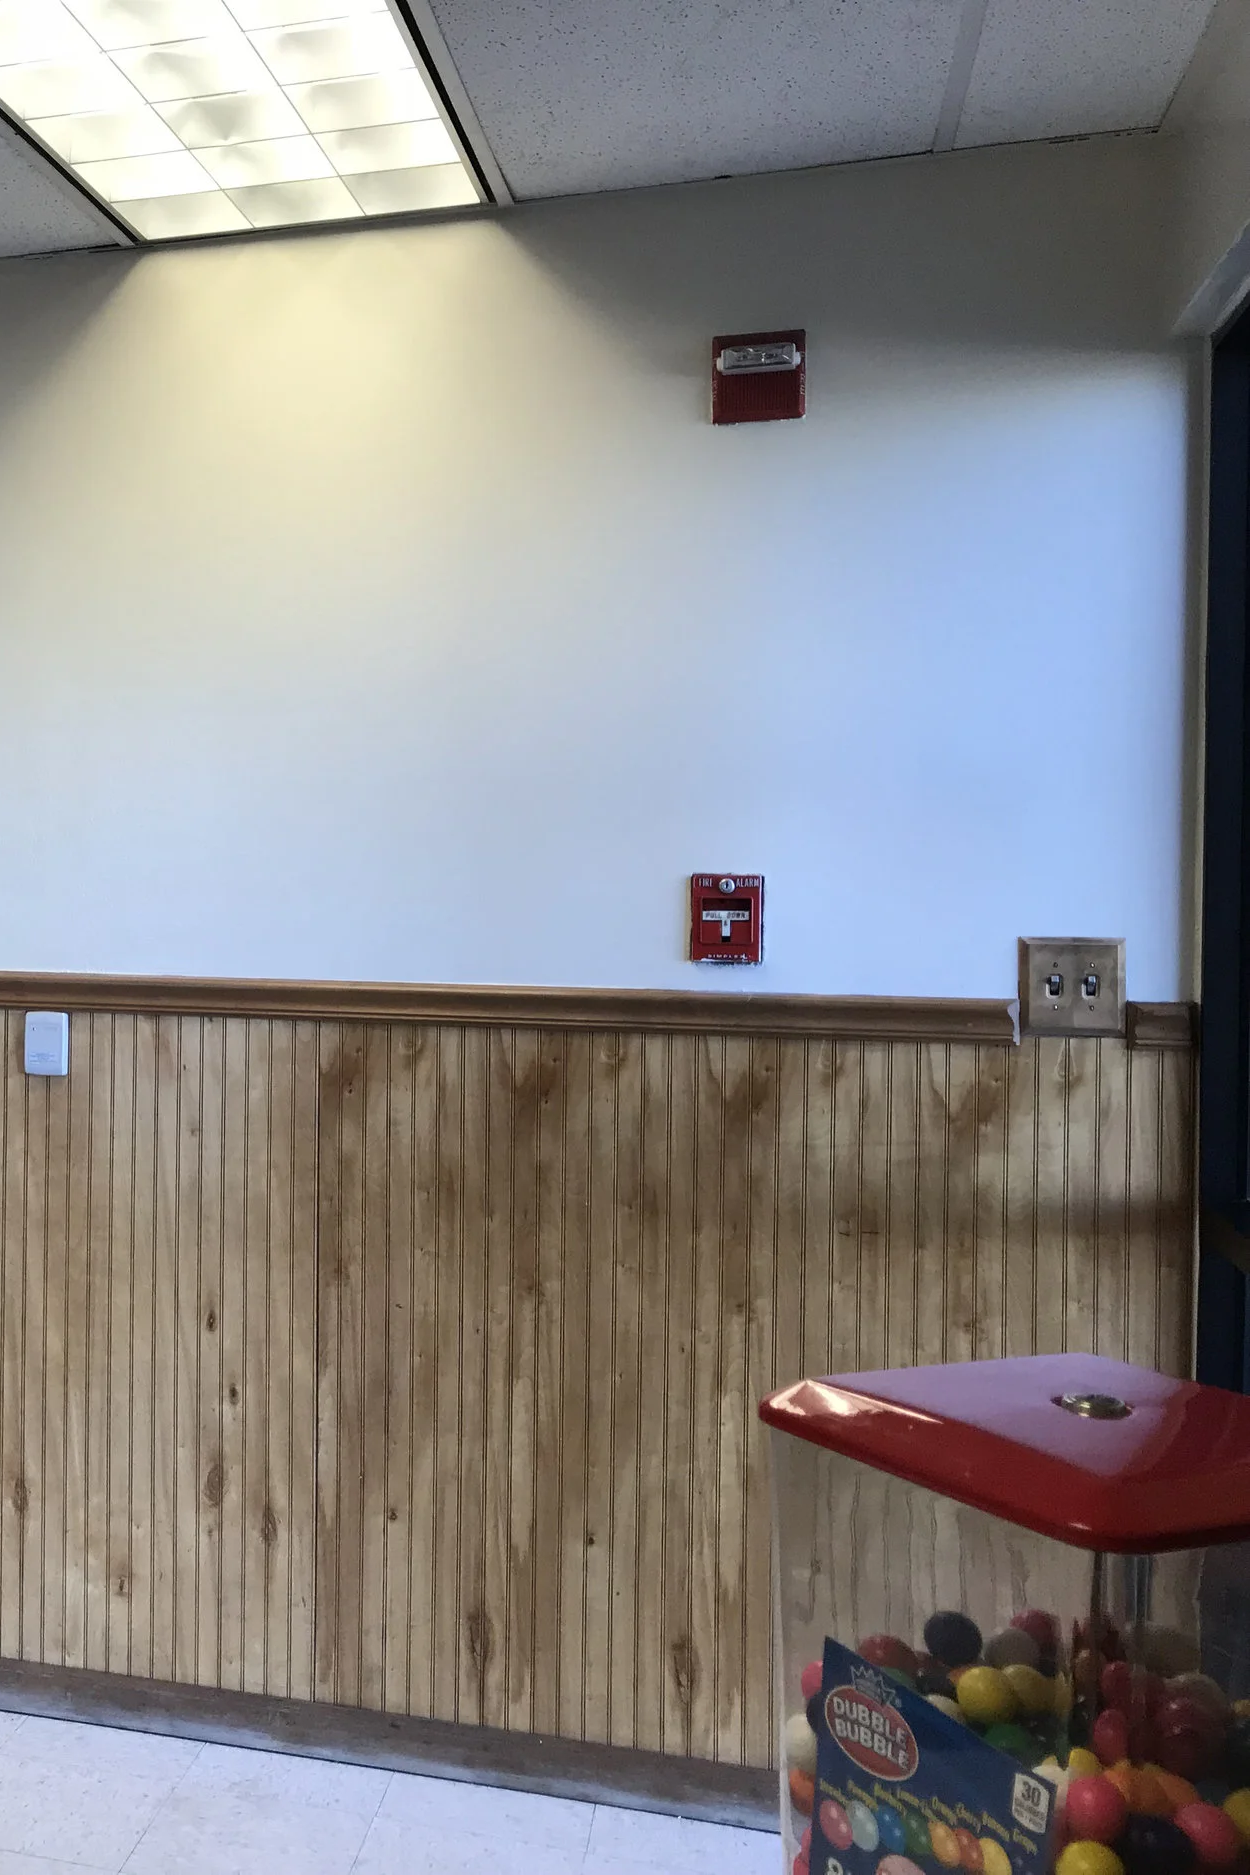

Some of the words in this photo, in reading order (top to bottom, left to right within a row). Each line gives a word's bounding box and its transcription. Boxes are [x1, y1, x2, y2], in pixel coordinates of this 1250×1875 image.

[699, 878, 713, 887] FIRE
[736, 878, 759, 887] ALARM
[833, 1696, 907, 1750] DUBBLE
[835, 1717, 909, 1770] BUBBLE
[1021, 1781, 1041, 1807] 30
